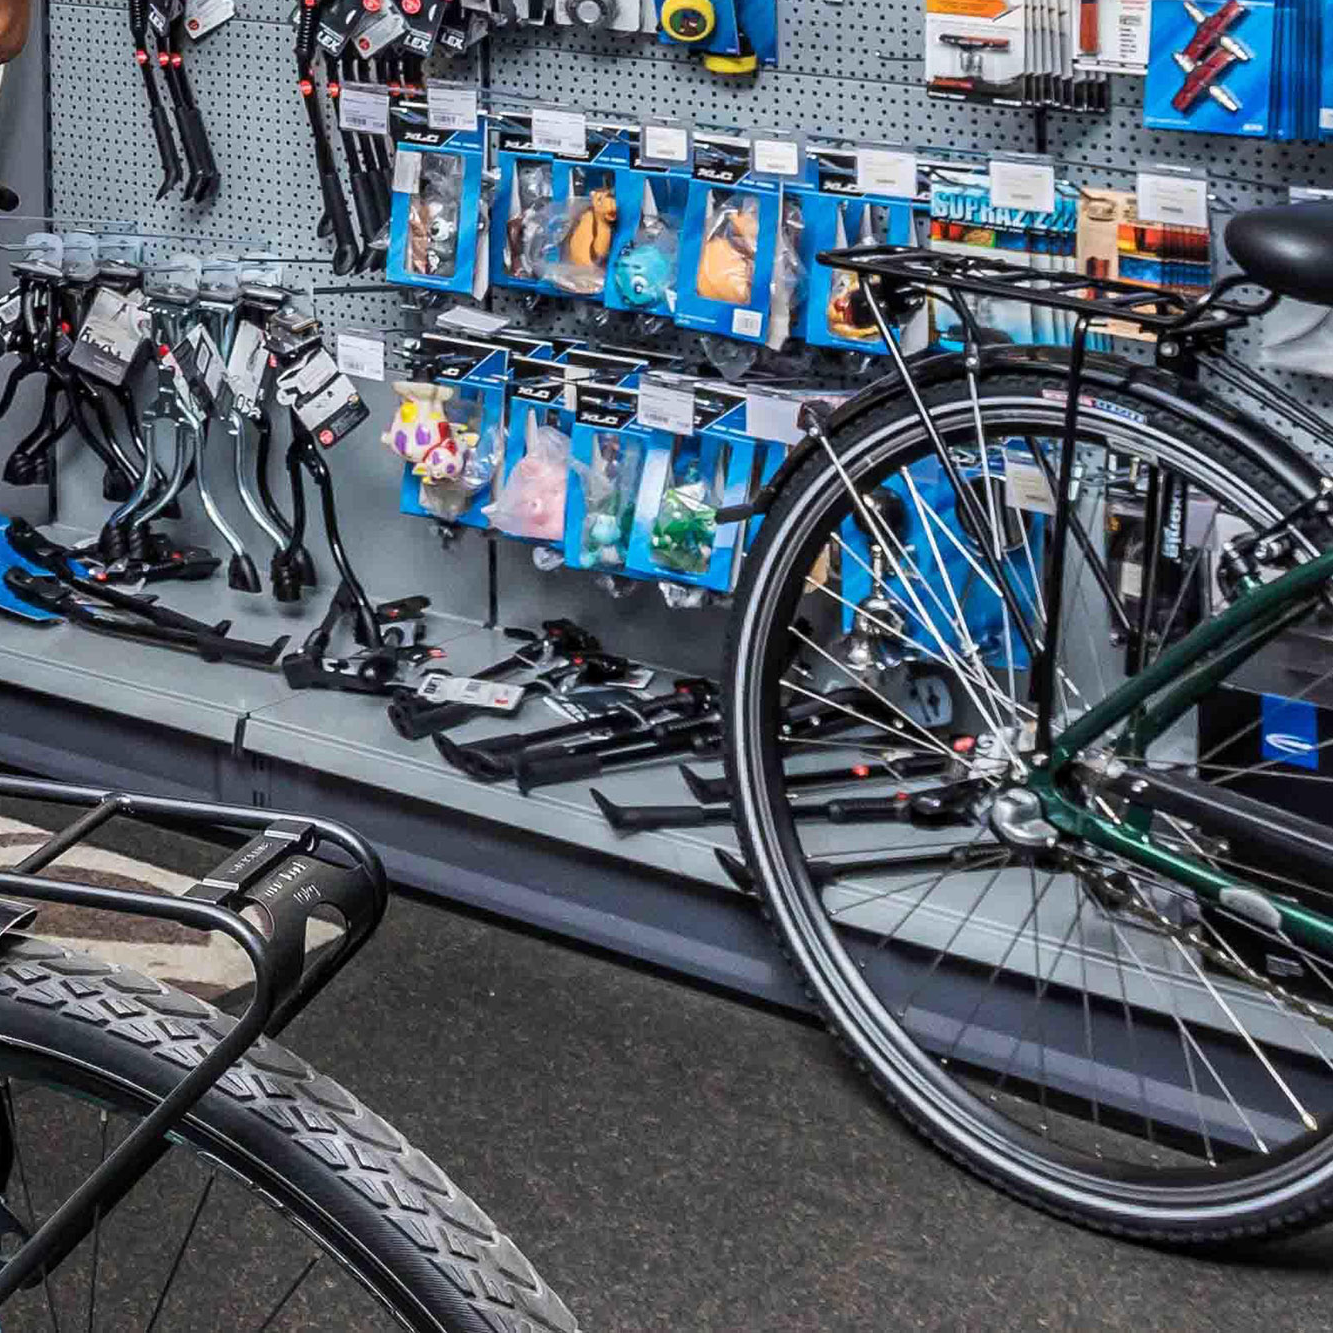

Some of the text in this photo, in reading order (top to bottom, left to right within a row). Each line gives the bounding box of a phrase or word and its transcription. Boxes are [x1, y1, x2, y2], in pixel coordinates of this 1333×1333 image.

[404, 131, 440, 145] XLC
[698, 167, 733, 180] XLC
[582, 412, 618, 425] XLC
